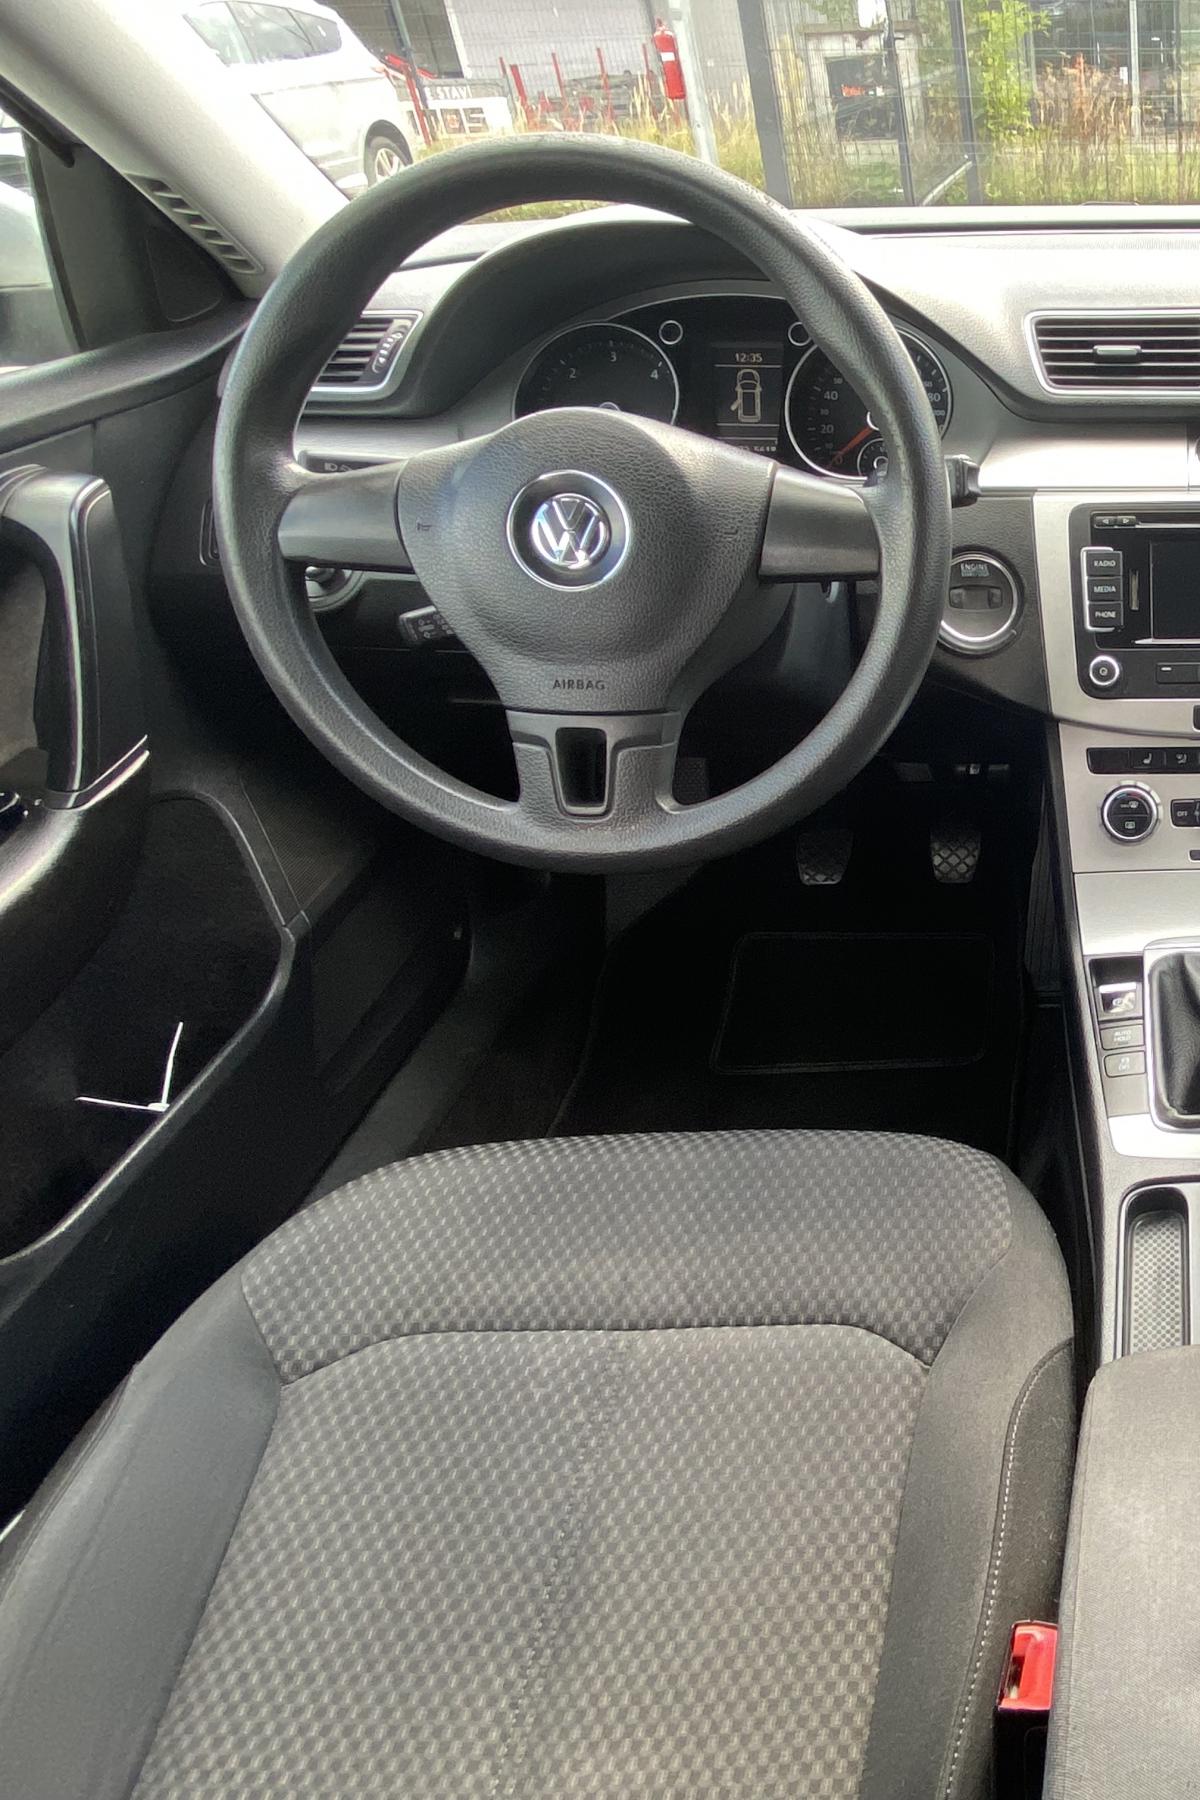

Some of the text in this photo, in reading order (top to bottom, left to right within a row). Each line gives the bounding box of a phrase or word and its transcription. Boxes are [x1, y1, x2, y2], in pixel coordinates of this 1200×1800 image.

[610, 351, 617, 362] 3
[735, 353, 763, 362] 12:35
[569, 368, 577, 378] 2
[650, 369, 658, 380] 4
[824, 391, 838, 401] 40
[820, 424, 834, 434] 20
[553, 679, 606, 690] AIRBAG
